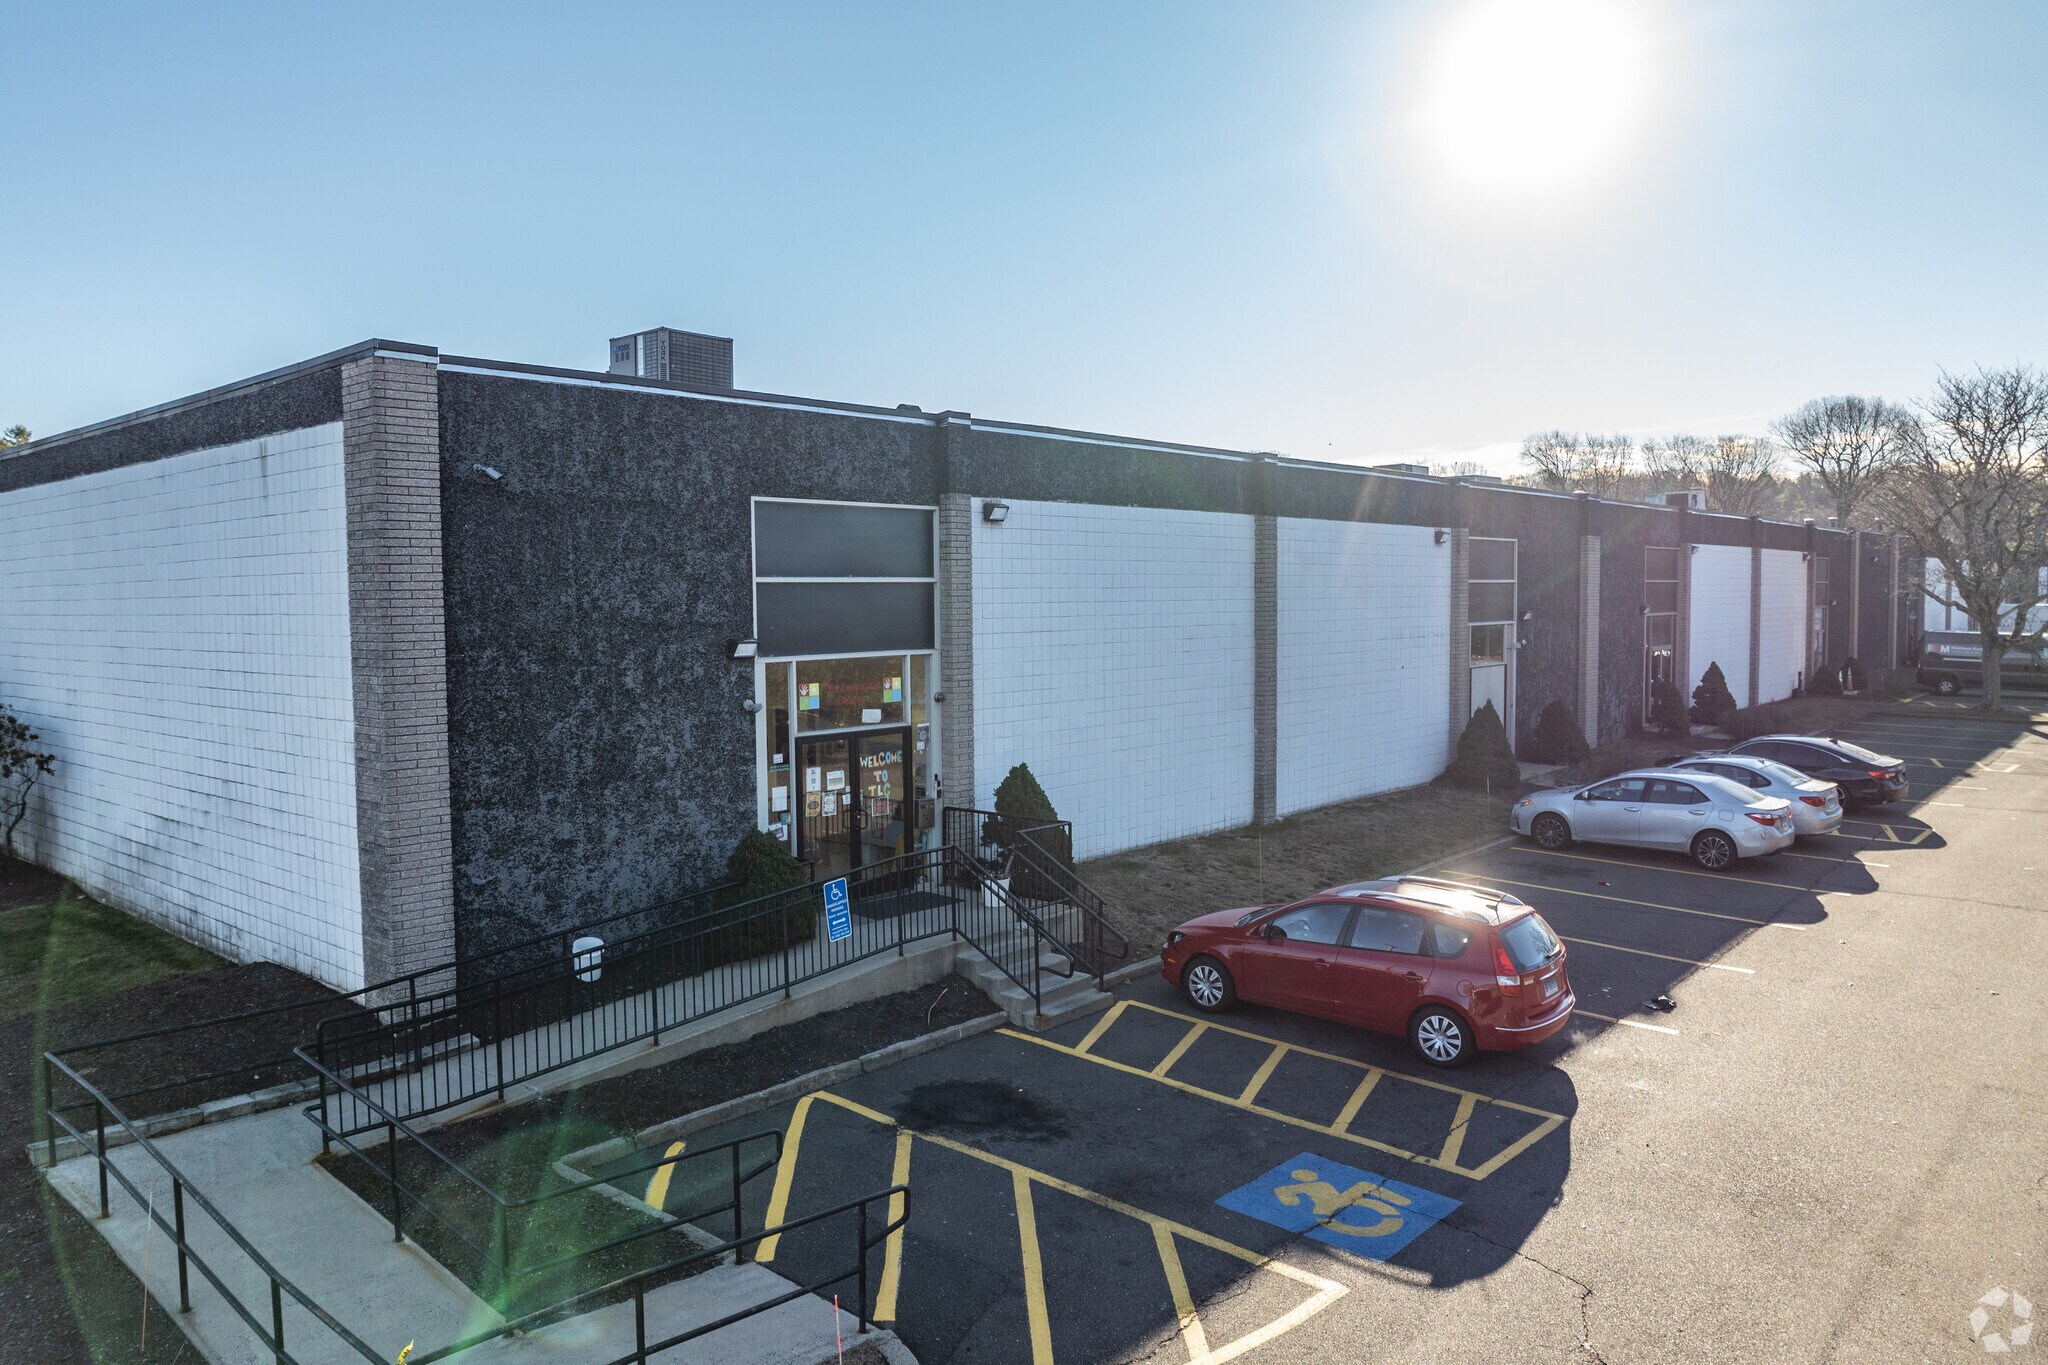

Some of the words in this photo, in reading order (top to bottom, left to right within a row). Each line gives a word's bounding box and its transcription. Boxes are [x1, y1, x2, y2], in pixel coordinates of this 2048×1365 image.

[859, 751, 903, 768] WELCOME
[873, 769, 888, 783] TO
[868, 783, 891, 796] TLC
